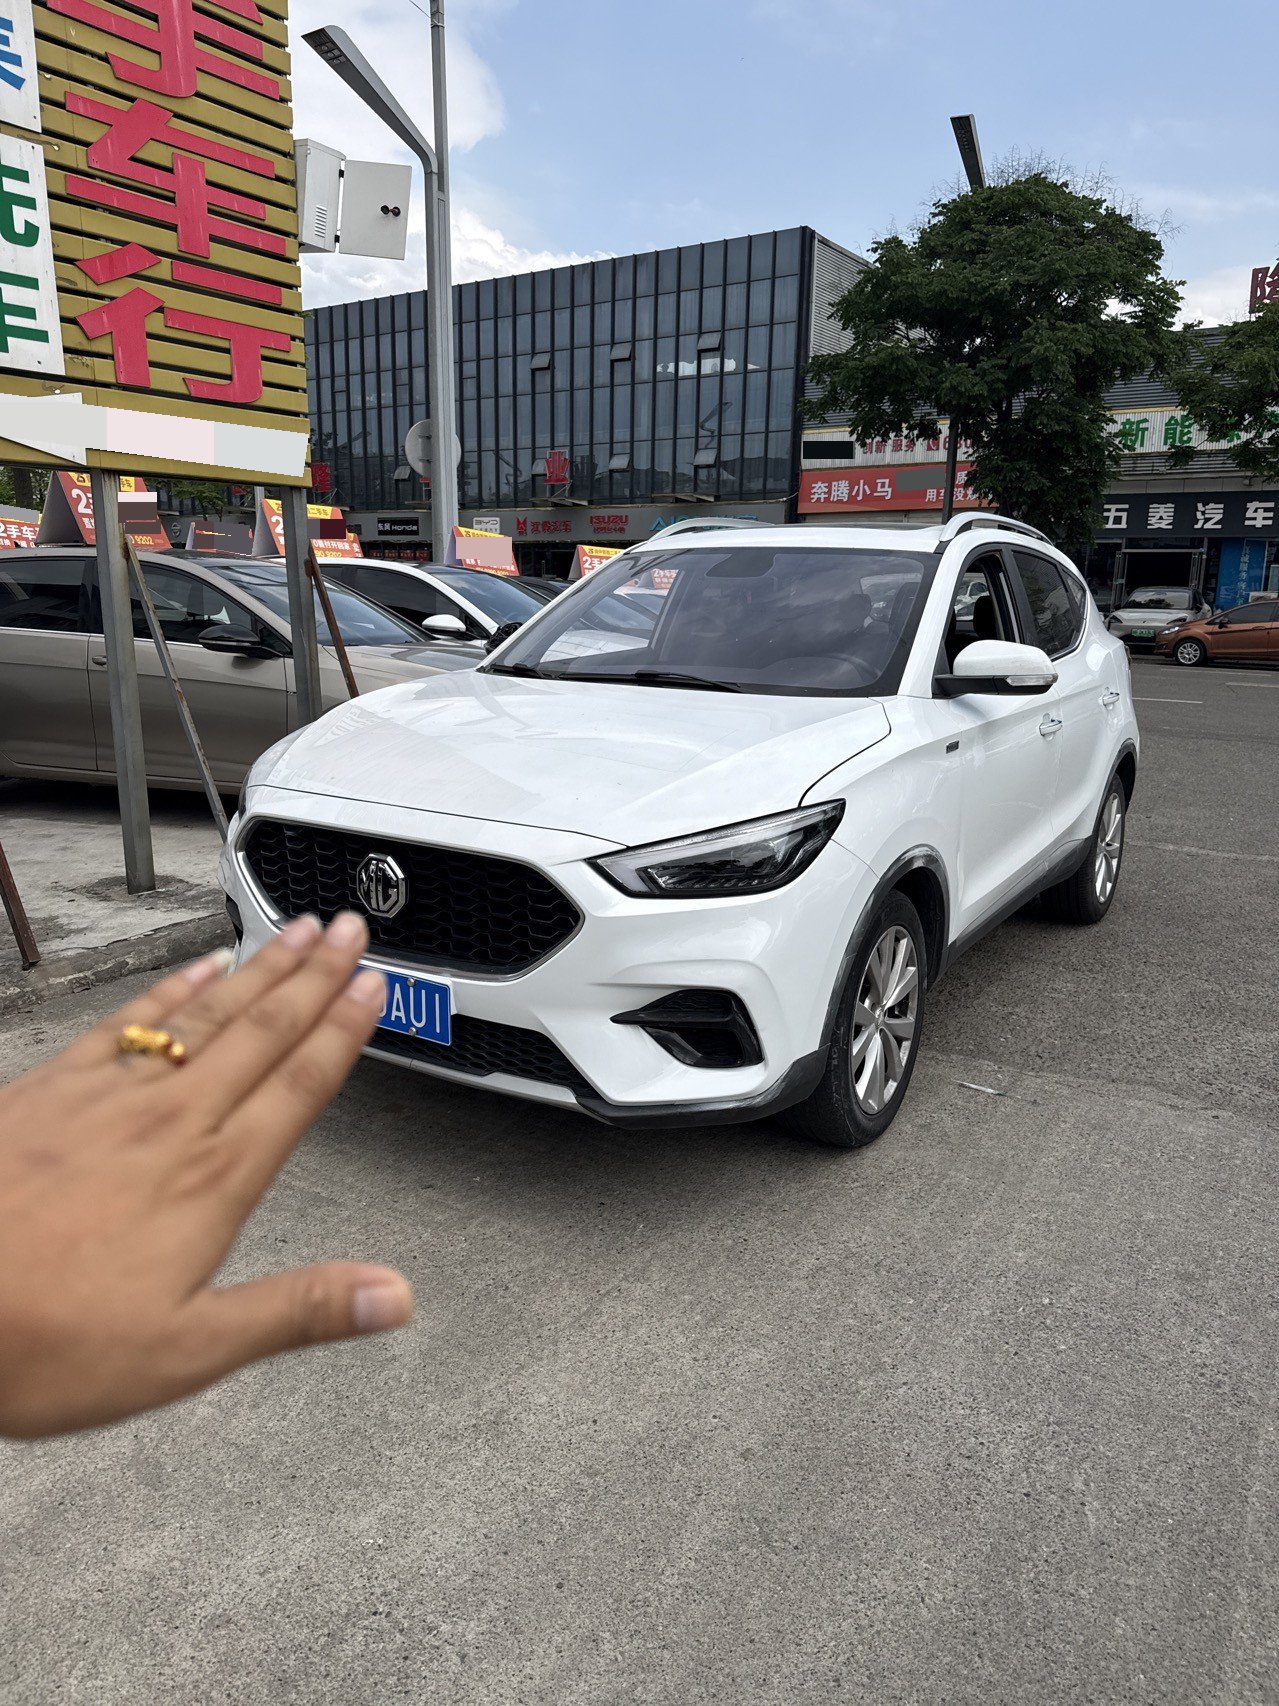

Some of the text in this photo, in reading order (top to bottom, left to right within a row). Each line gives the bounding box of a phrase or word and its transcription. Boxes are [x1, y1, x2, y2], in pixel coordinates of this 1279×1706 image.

[810, 478, 893, 503] 奔腾小马
[590, 515, 629, 526] ISUZU
[1103, 501, 1275, 529] 五菱汽车
[0, 522, 40, 541] 2手车
[391, 524, 418, 532] Honda
[360, 860, 399, 910] MG
